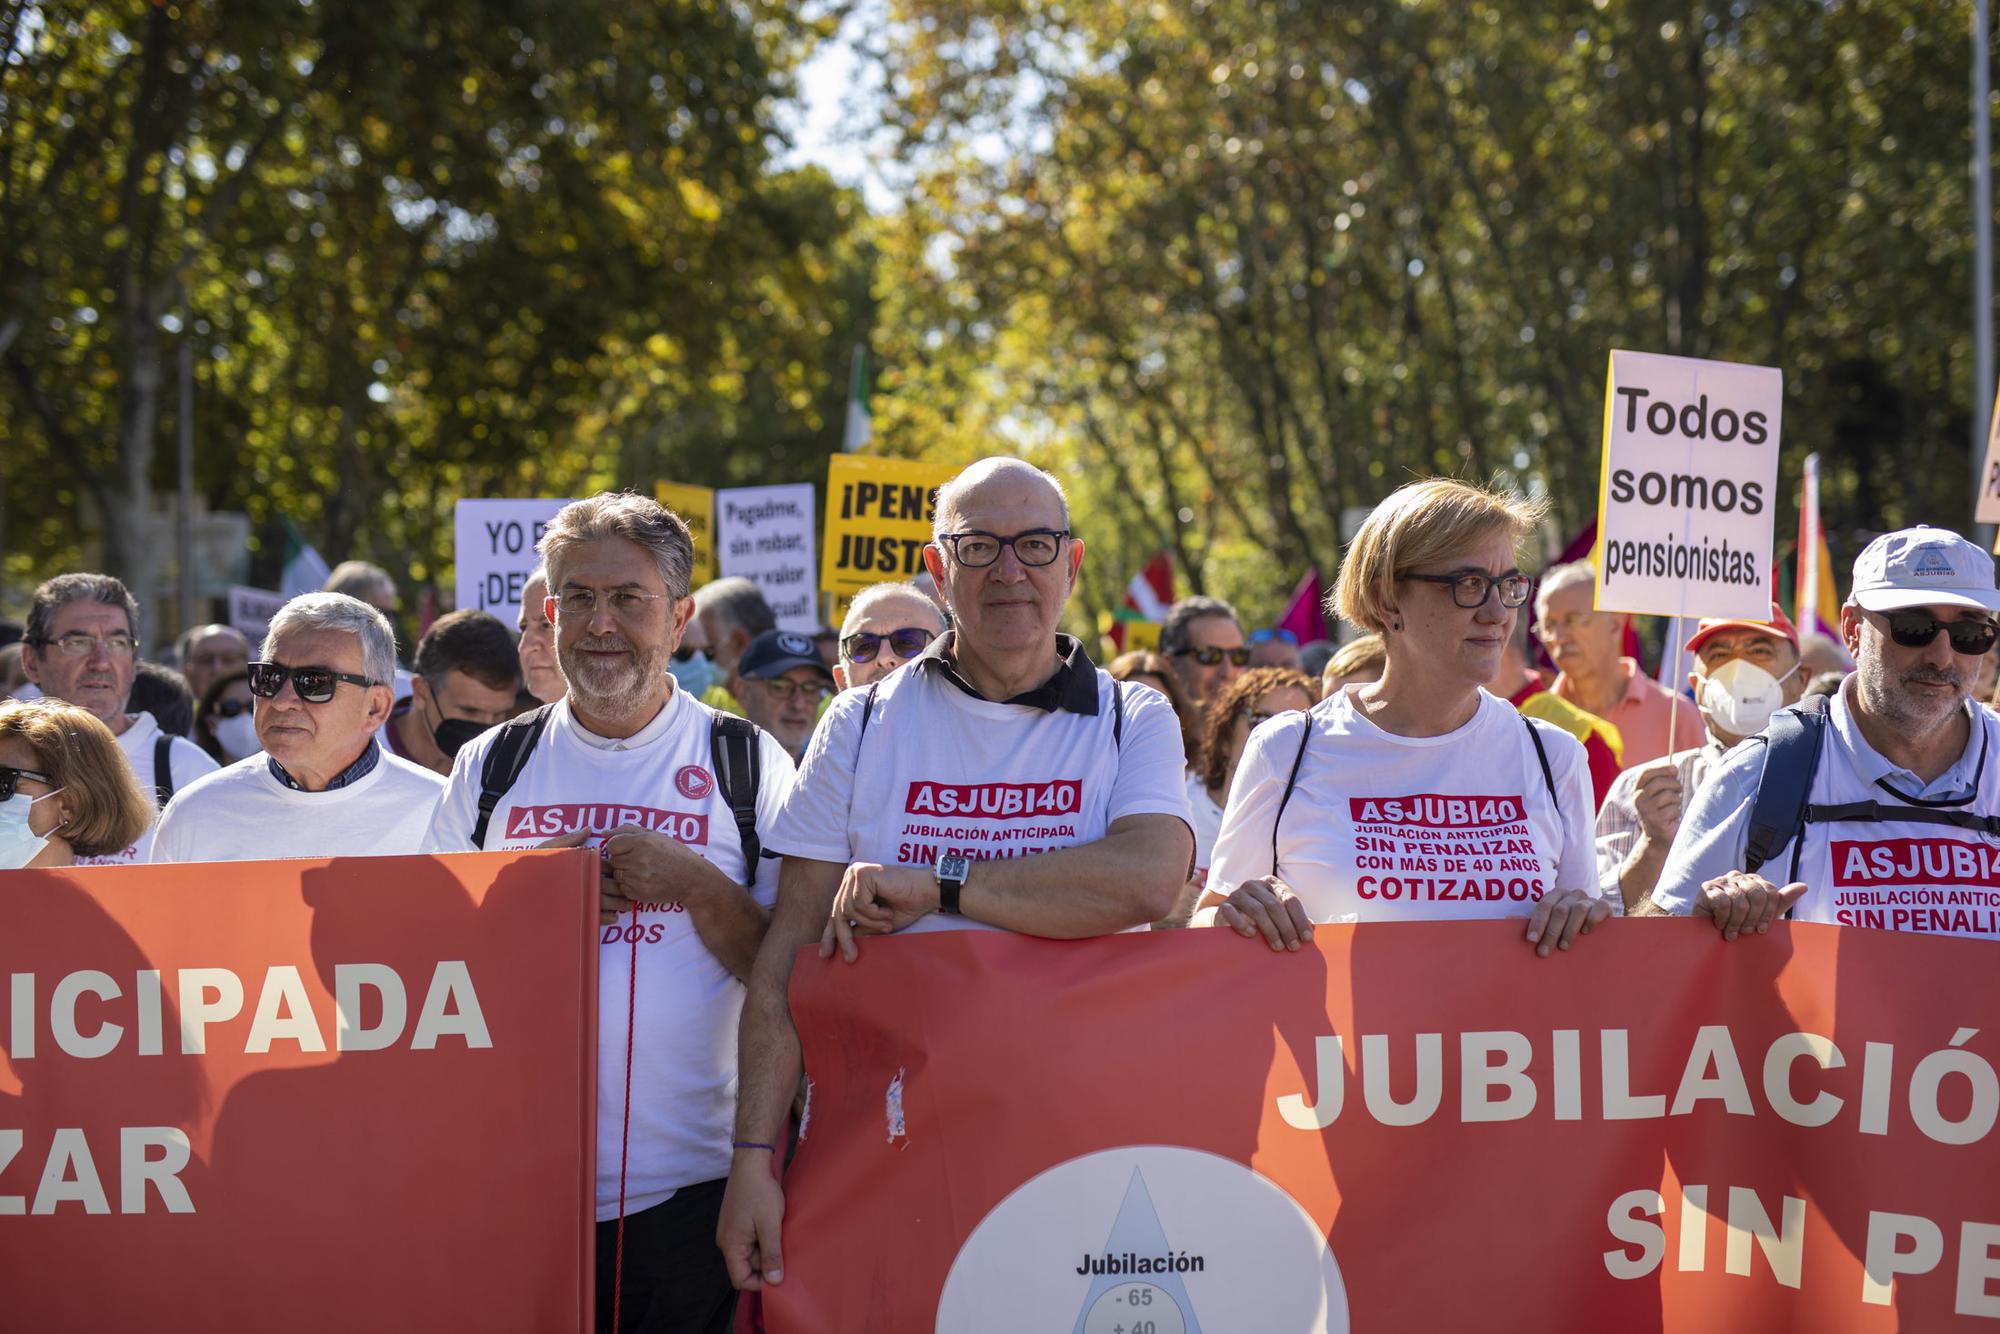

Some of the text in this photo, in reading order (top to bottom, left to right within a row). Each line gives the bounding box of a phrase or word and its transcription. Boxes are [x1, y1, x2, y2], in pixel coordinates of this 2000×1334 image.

[1617, 386, 1768, 445] Todos
[1611, 469, 1764, 515] somos
[486, 522, 524, 554] YO
[730, 534, 753, 556] sin
[1605, 532, 1760, 586] pensionistas.
[763, 563, 805, 585] valor
[912, 784, 1076, 815] ASJUBI40
[1360, 798, 1517, 825] ASJUBI40
[902, 824, 1075, 841] JUBILACIÓN ANTICIPADA
[1354, 824, 1528, 840] JUBILACIÓN ANTICIPADA
[897, 843, 938, 865] SIN
[1355, 837, 1536, 856] SIN PENALIZAR
[1355, 855, 1541, 873] CON MÁS DE 40 AÑOS
[1357, 876, 1544, 902] COTIZADOS
[1835, 887, 1945, 906] JUBILACIÓN
[1892, 908, 2000, 934] PENALI
[10, 961, 493, 1059] ICIPADA
[1276, 1026, 2000, 1145] JUBILACIÓ
[1603, 1184, 1806, 1290] SIN
[1076, 1251, 1204, 1276] Jubilación
[1128, 1289, 1153, 1307] 65
